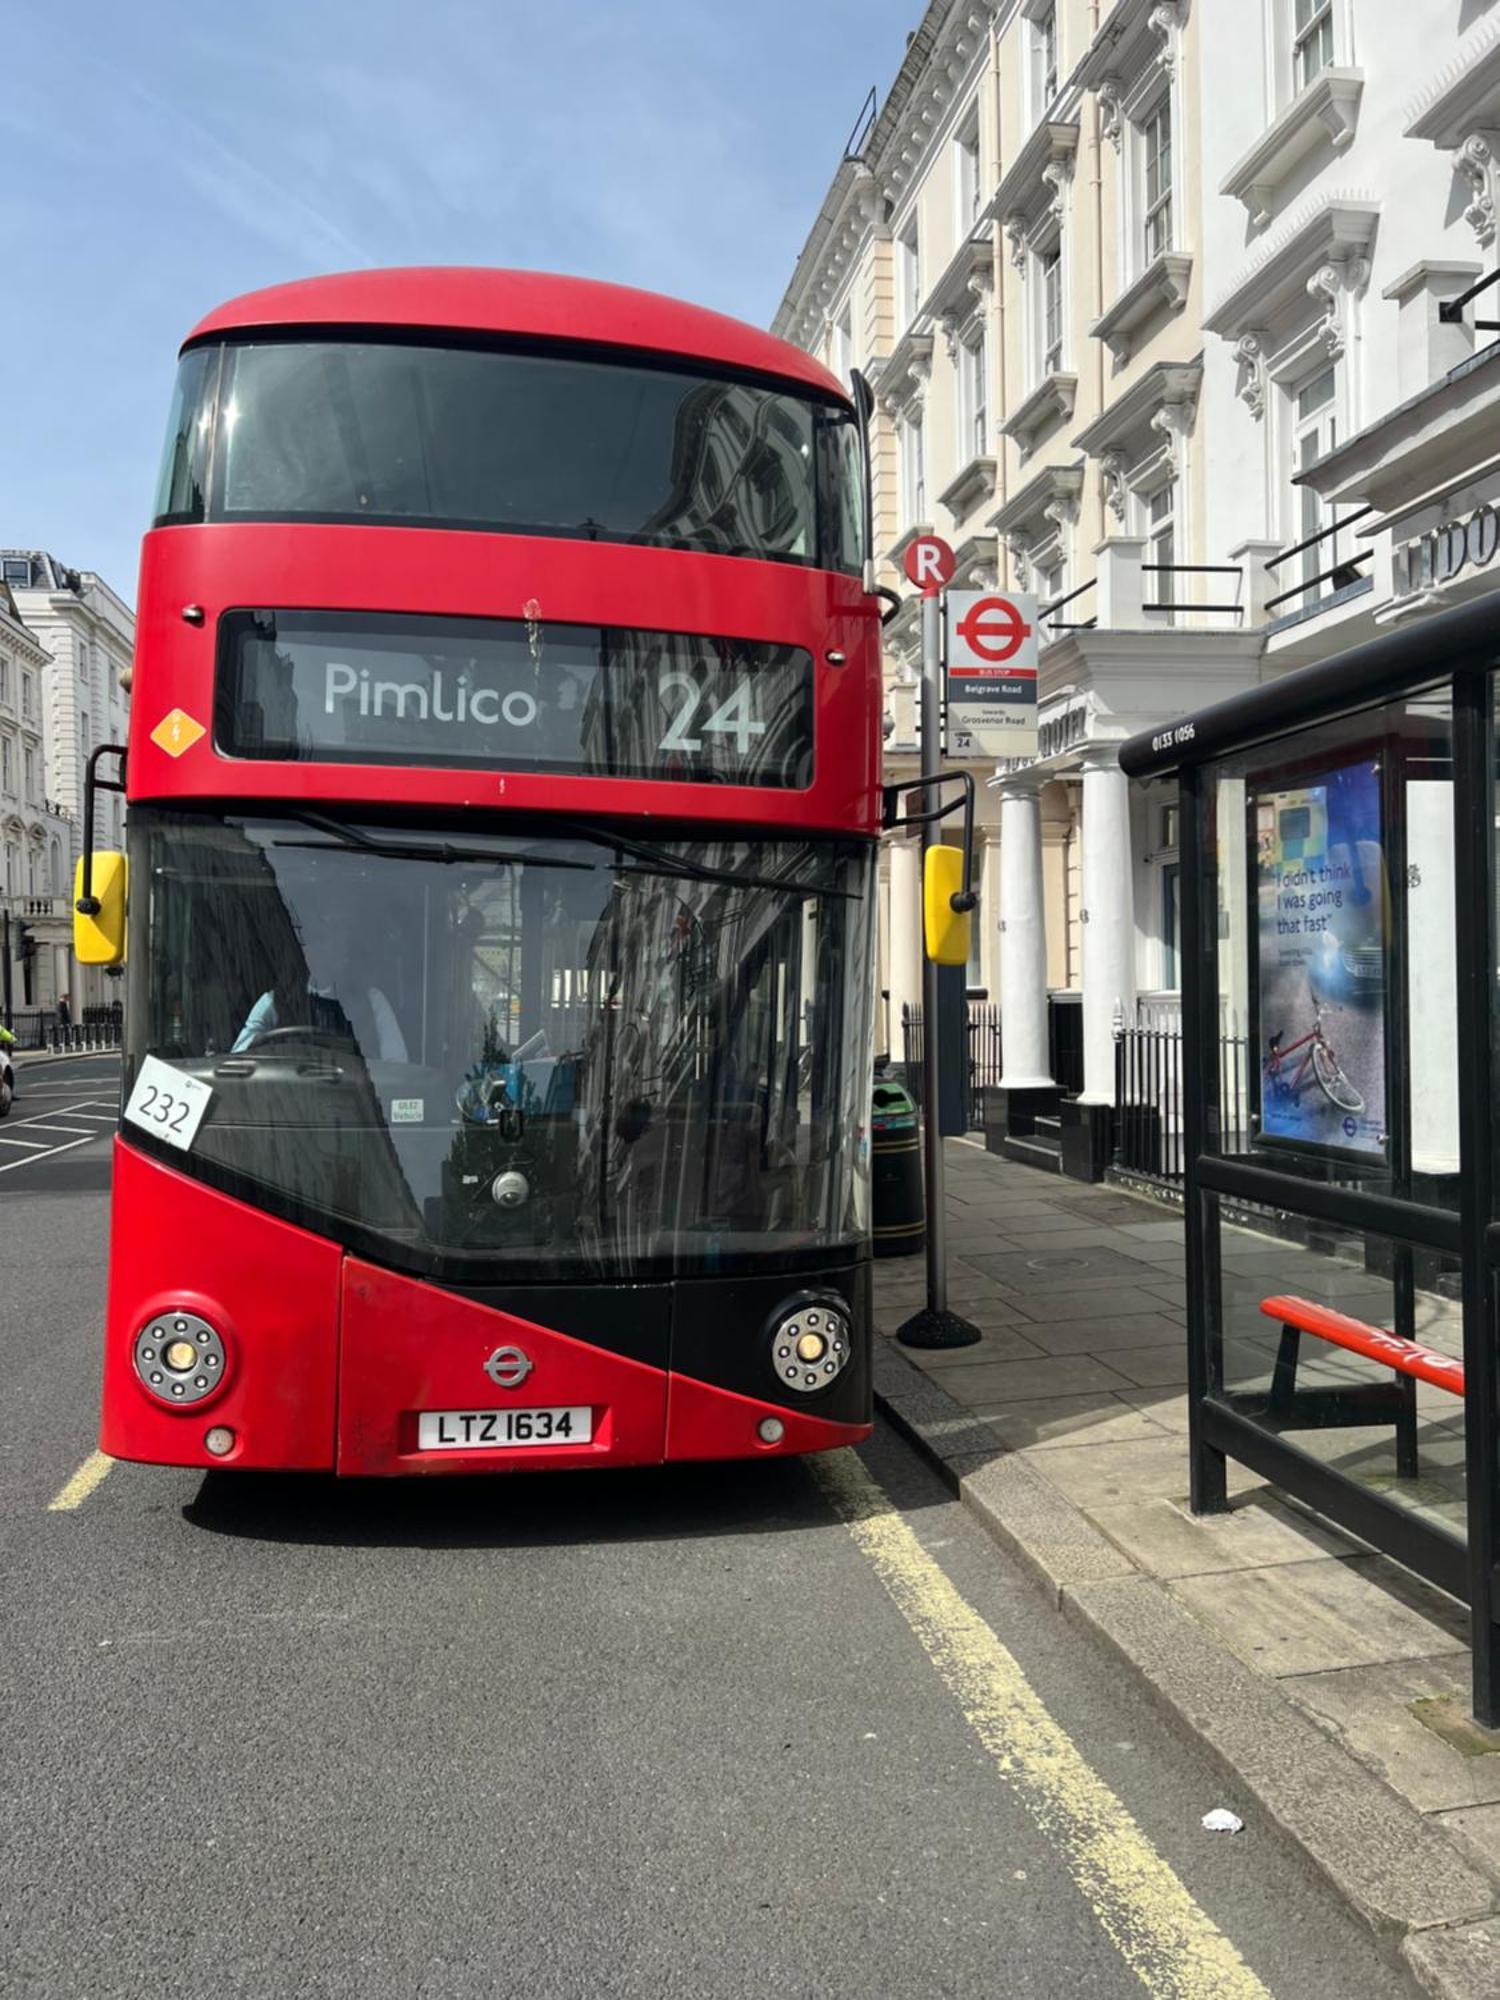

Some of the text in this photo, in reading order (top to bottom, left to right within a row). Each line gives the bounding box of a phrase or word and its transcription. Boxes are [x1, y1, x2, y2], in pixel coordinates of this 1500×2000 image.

[916, 543, 945, 582] R
[964, 685, 1023, 695] Belgrave Road
[325, 662, 766, 754] Pimlico 24
[961, 715, 1026, 726] Grosvenor Road
[957, 737, 970, 748] 24
[1320, 862, 1351, 882] think
[1283, 895, 1306, 909] was
[1308, 890, 1343, 911] going
[1277, 918, 1301, 934] that
[139, 1085, 190, 1133] 232
[439, 1412, 572, 1443] LTZ 1634
